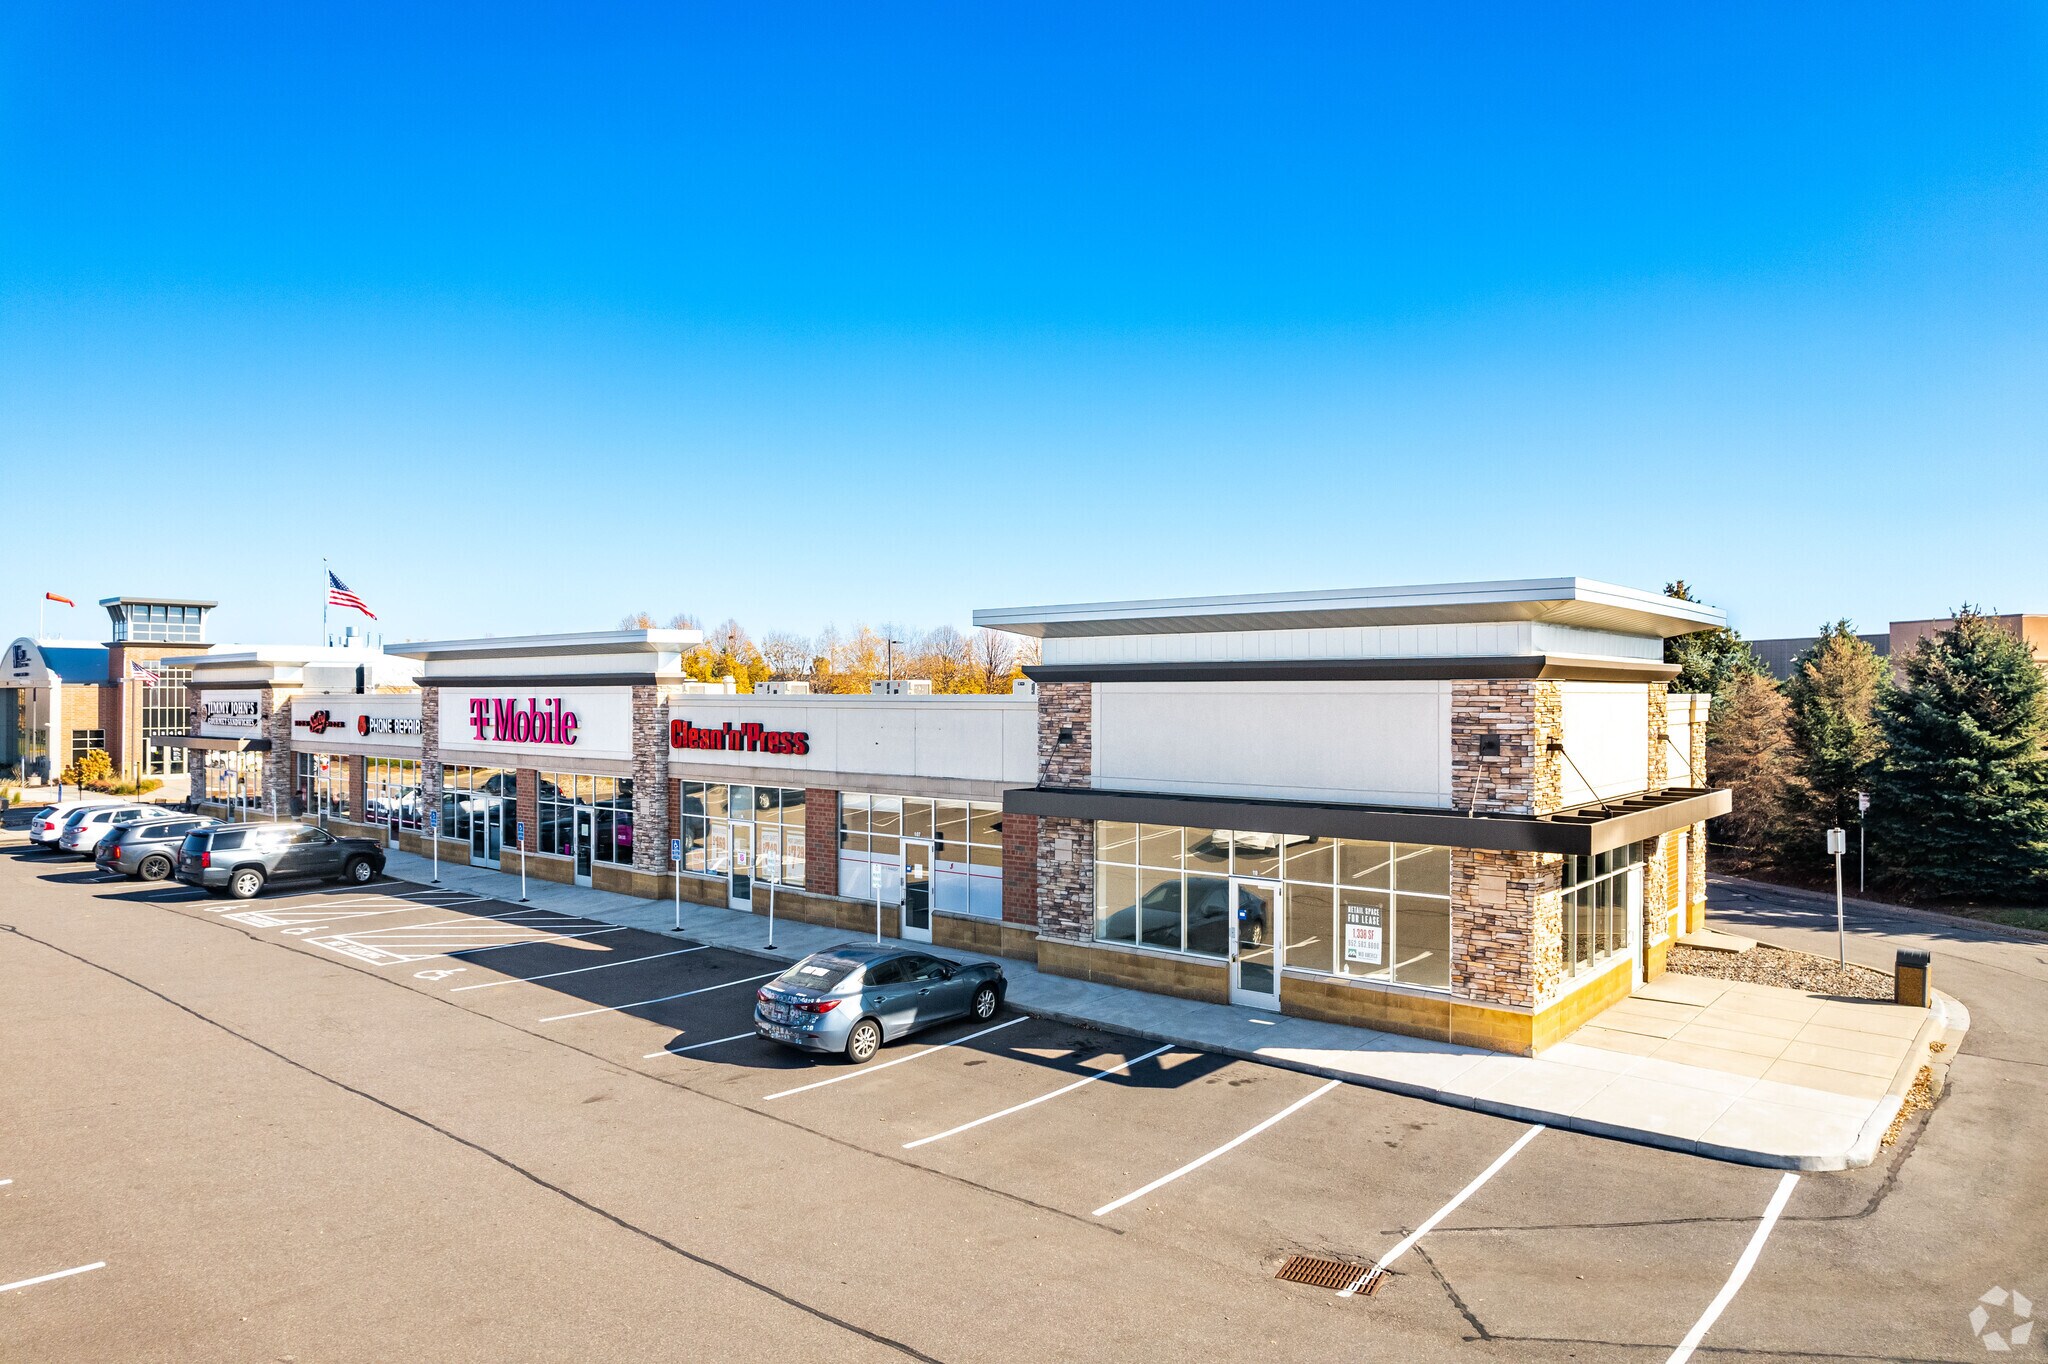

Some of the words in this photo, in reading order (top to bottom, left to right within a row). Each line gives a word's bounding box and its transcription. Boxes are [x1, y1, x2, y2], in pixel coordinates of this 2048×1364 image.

[207, 701, 229, 716] JIMMY
[230, 701, 256, 716] JOHN'S
[370, 718, 393, 734] PHONE
[394, 719, 422, 735] REPAIR
[1347, 905, 1364, 914] RETAIL
[1365, 907, 1380, 916] SPACE
[1347, 914, 1360, 923] FOR
[1361, 915, 1380, 926] LEASE
[1368, 930, 1375, 940] SF
